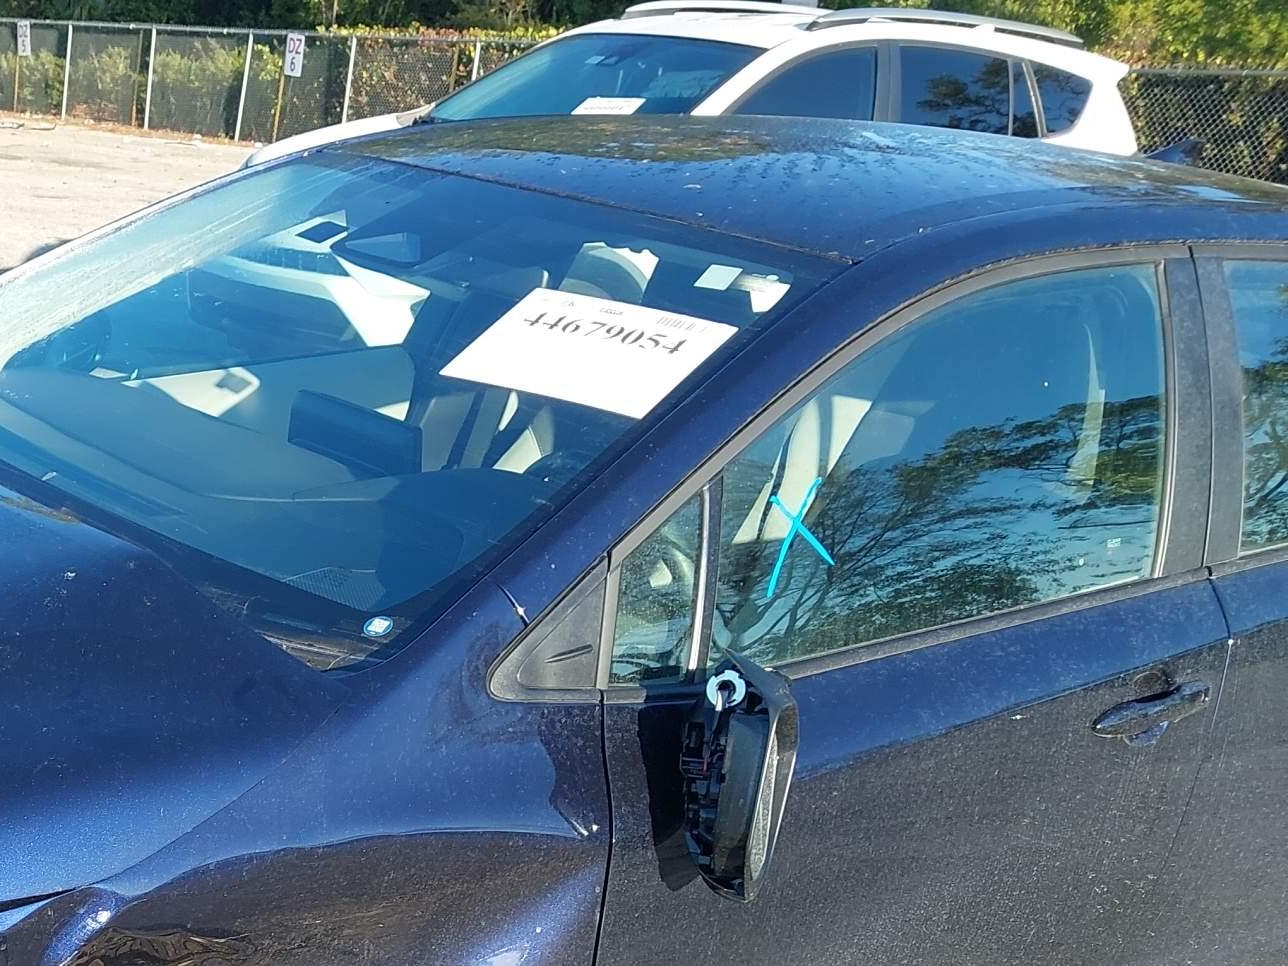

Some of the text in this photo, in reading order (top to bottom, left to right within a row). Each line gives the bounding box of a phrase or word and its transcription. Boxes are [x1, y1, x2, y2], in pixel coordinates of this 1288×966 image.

[288, 37, 302, 55] DZ
[290, 56, 296, 72] 6
[523, 312, 688, 355] 44679054
